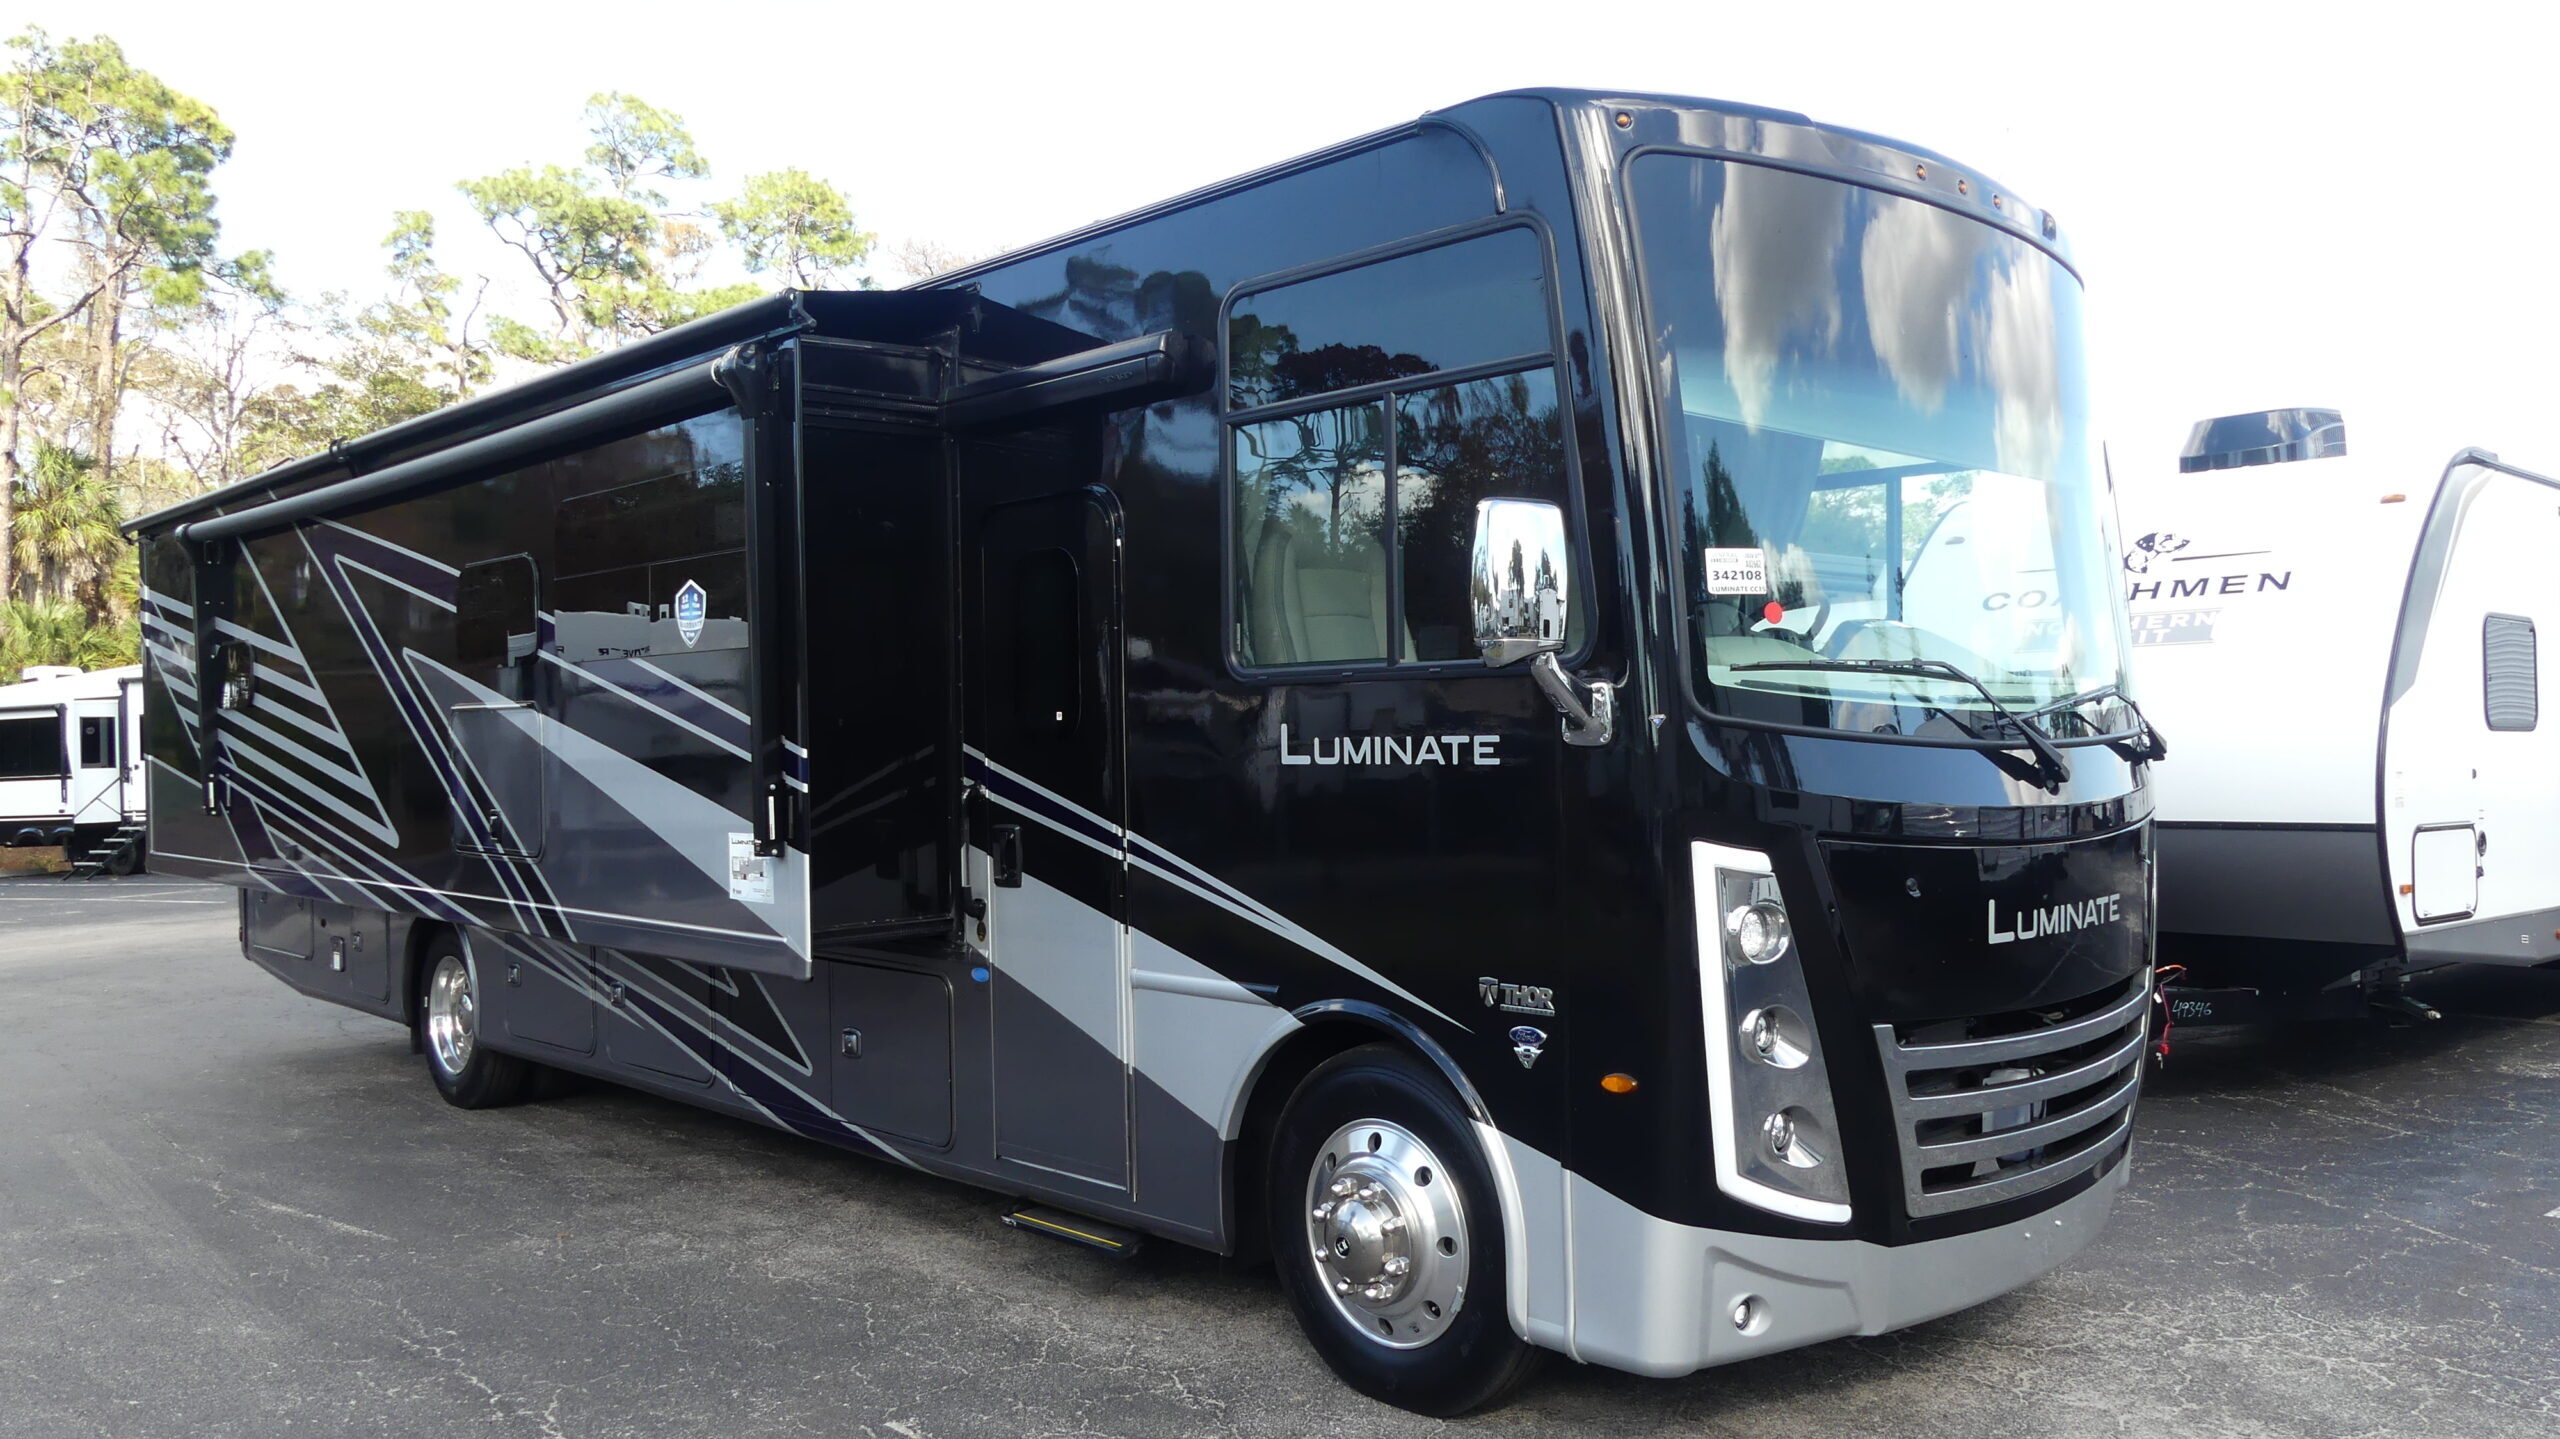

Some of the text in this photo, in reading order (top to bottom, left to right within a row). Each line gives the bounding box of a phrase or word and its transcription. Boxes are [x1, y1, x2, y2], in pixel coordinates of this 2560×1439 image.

[1713, 570, 1762, 580] 342108
[1280, 723, 1501, 766] LUMINATE
[1988, 893, 2121, 944] LUMINATE
[1500, 983, 1555, 1010] THOR
[2172, 1000, 2212, 1018] 49346
[1515, 1028, 1538, 1043] Ford
